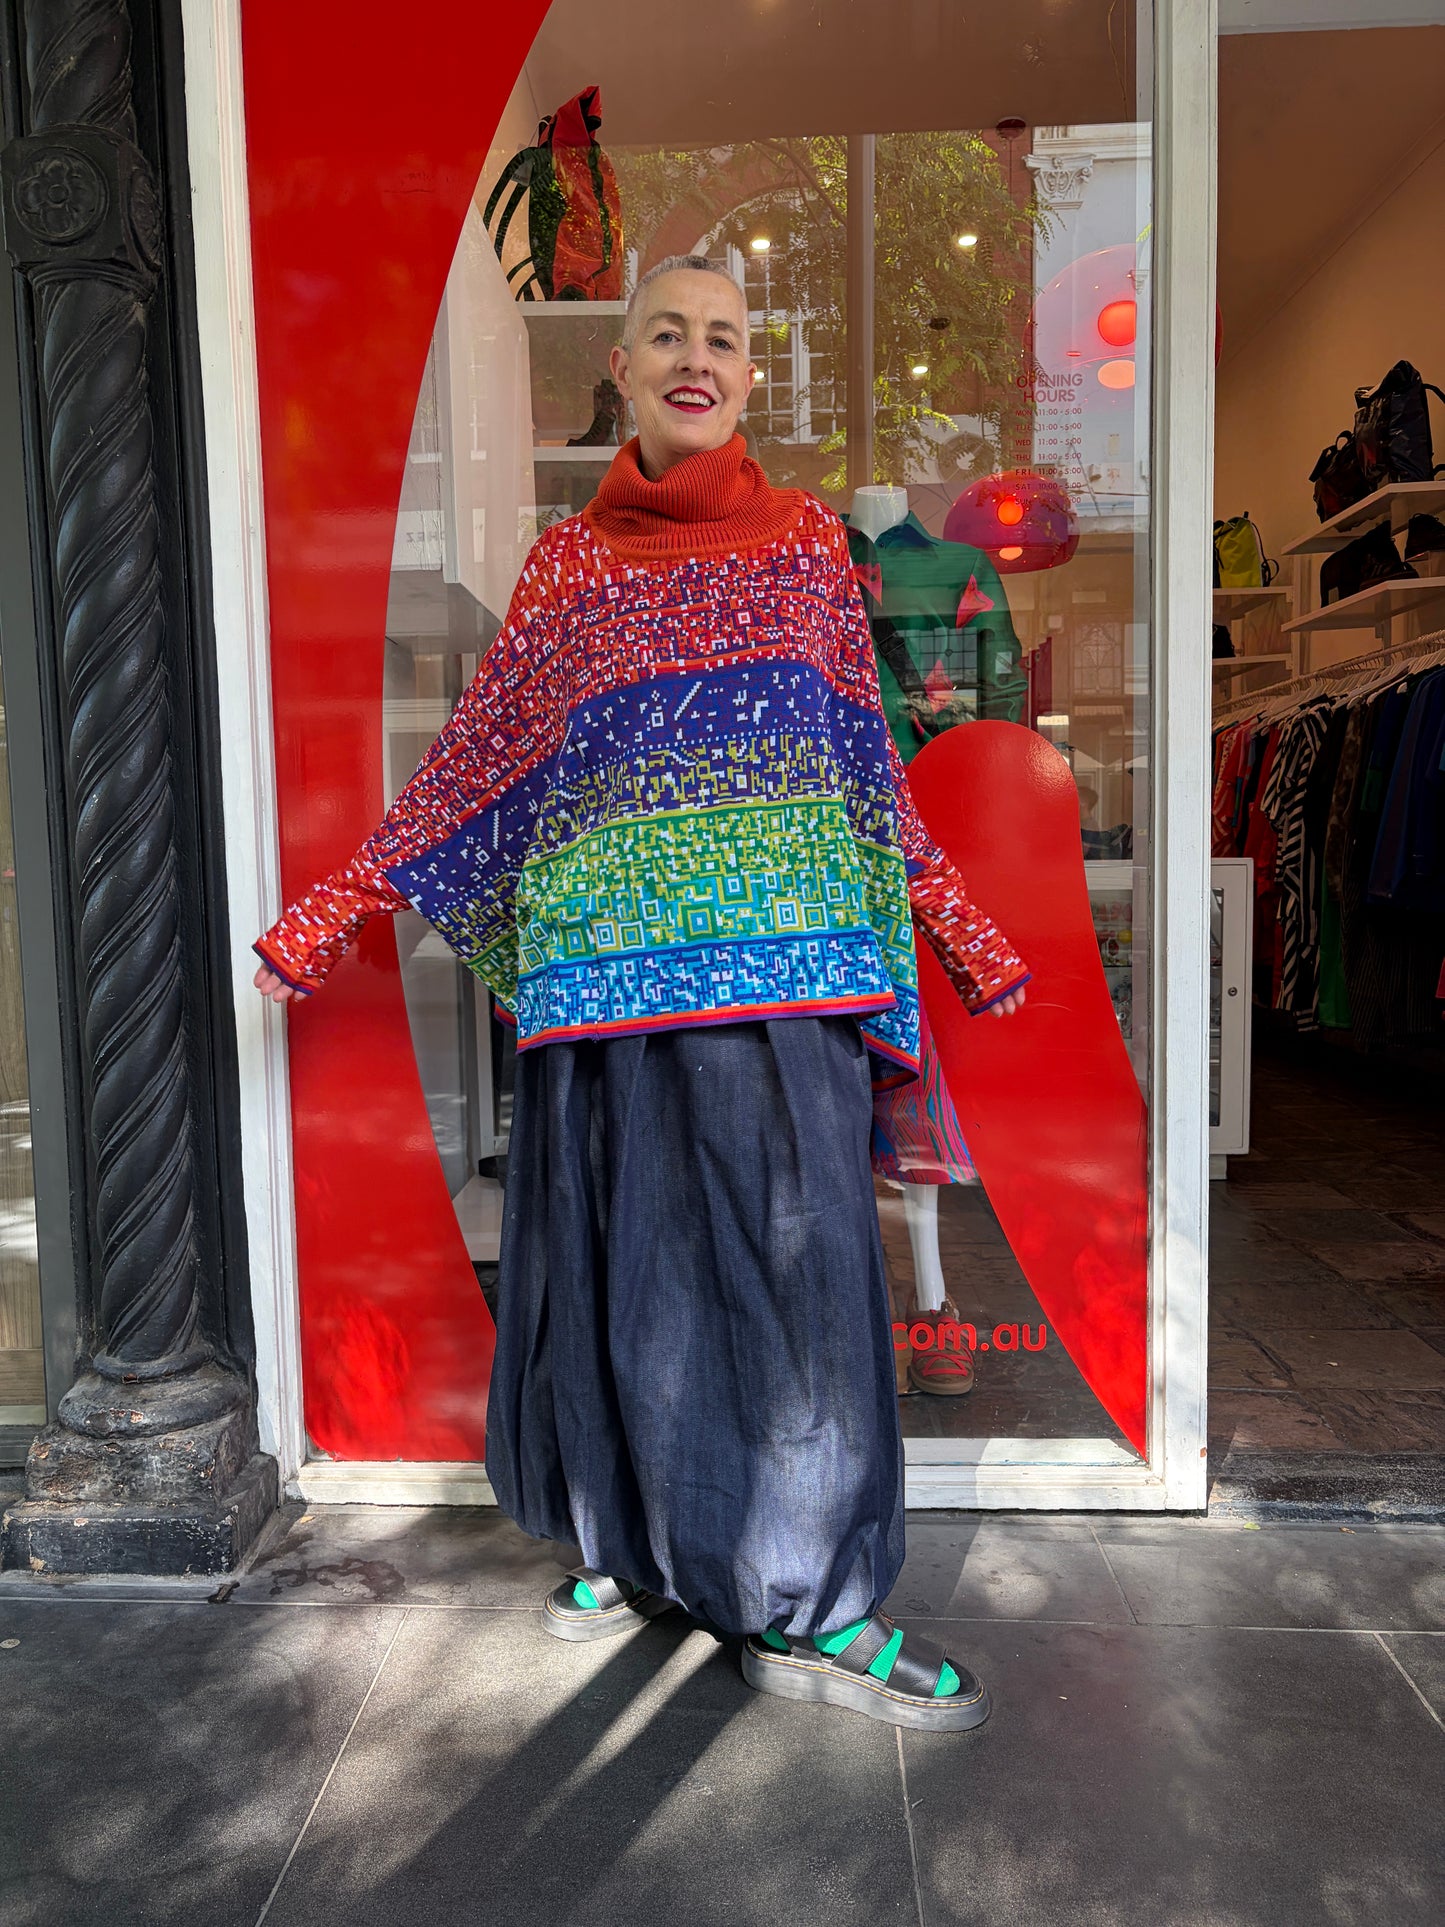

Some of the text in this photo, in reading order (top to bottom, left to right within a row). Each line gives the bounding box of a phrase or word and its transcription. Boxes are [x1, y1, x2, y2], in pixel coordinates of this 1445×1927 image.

[1016, 373, 1083, 388] OPENING
[1023, 389, 1076, 403] HOURS
[1065, 408, 1082, 416] 5:00
[1038, 423, 1058, 431] 11:00
[1038, 438, 1058, 446] 11:00
[1065, 438, 1082, 446] 5:00
[1038, 453, 1058, 461] 11:00
[1065, 452, 1082, 460] 5:00
[1065, 467, 1082, 475] 5:00
[892, 1321, 1047, 1352] com.au
